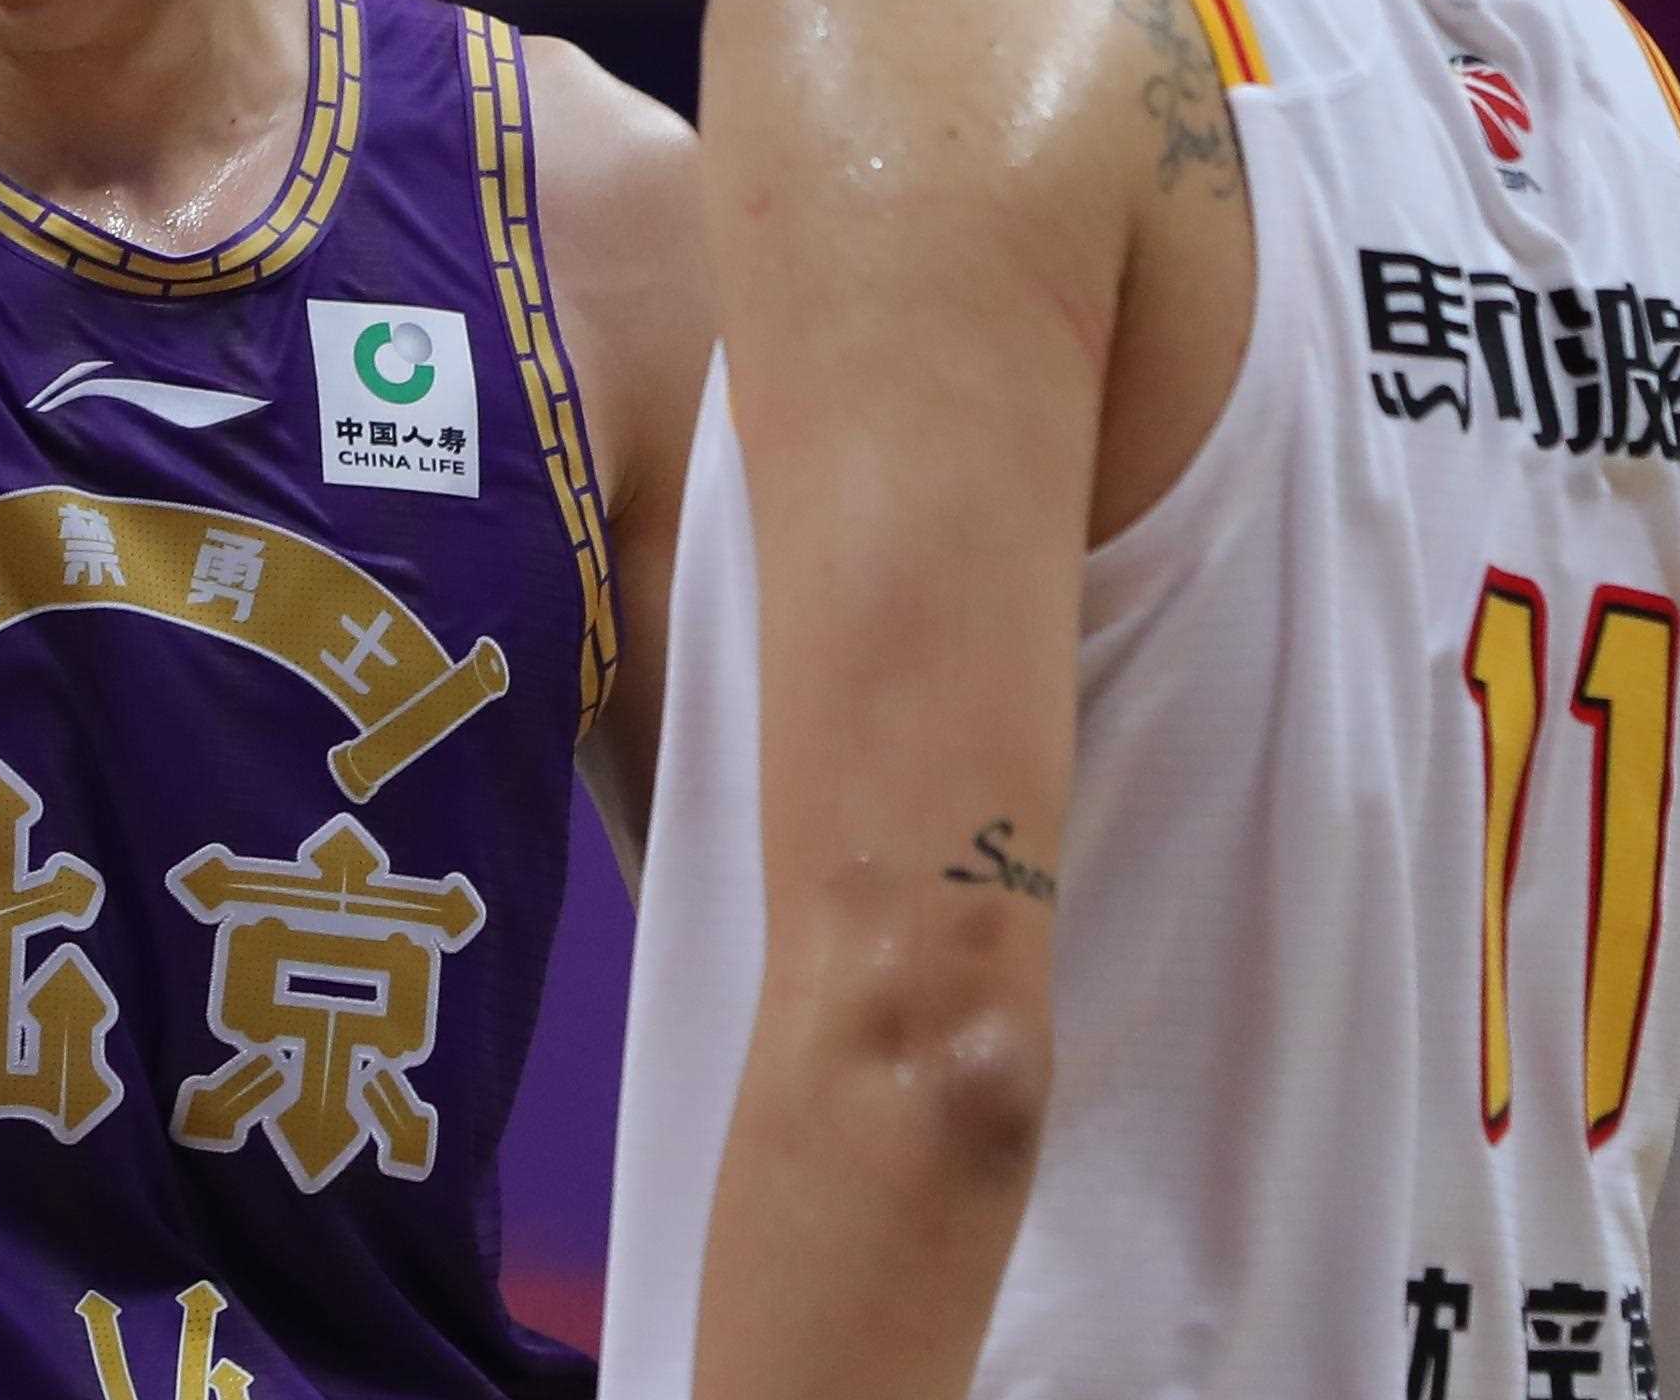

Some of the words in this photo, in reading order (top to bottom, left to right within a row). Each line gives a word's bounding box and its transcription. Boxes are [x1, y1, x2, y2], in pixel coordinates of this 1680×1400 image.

[336, 417, 466, 454] 中国人寿
[338, 451, 411, 470] CHINA
[419, 457, 465, 475] LIFE
